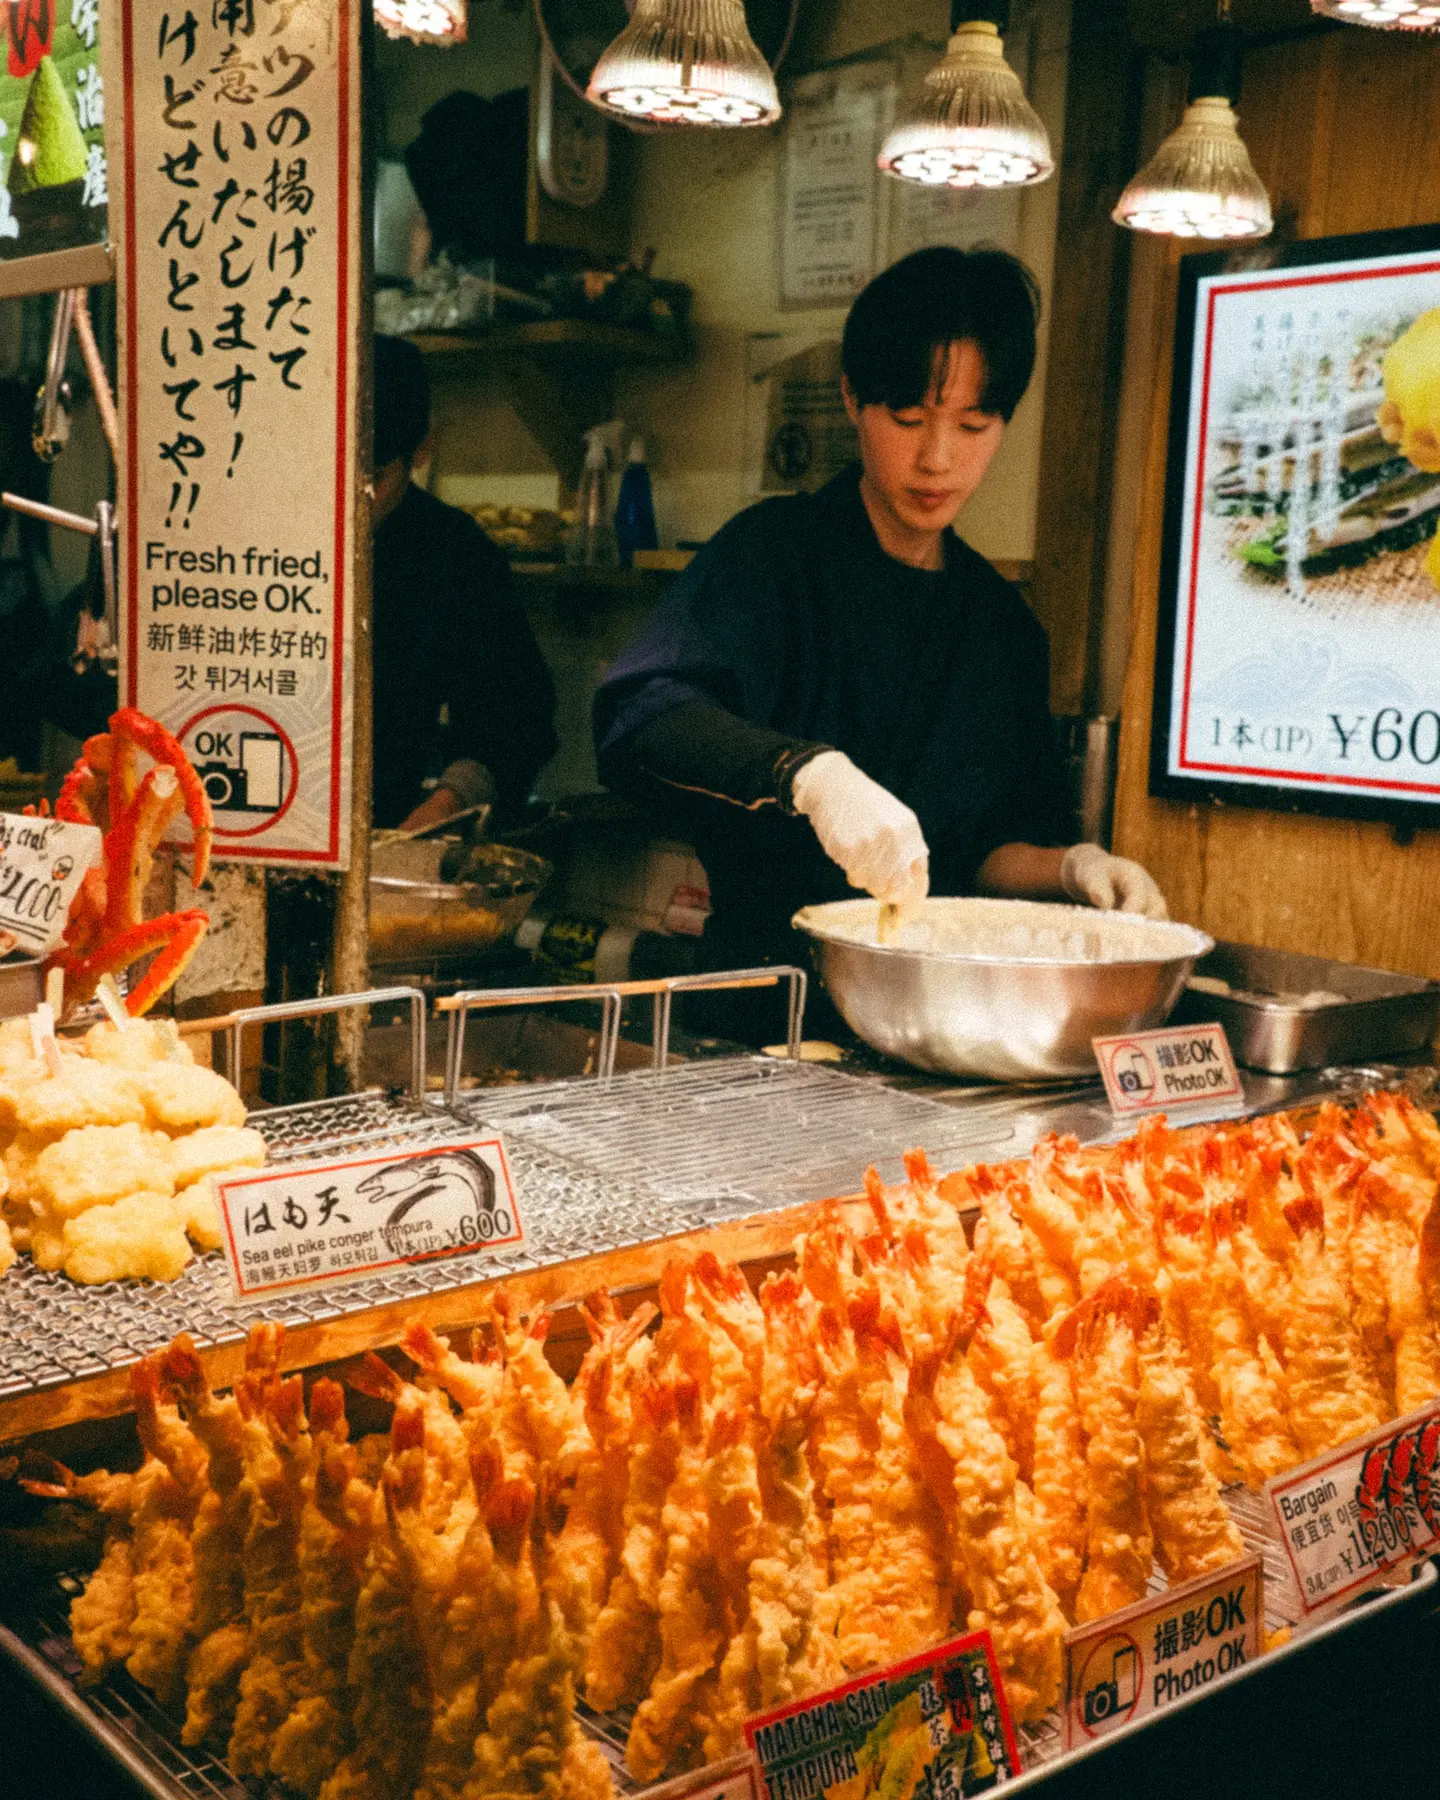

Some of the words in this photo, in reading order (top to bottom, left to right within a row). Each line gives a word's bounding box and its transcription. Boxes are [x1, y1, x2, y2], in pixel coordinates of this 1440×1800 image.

[146, 541, 236, 574] Fresh
[242, 546, 329, 583] fried,
[151, 578, 258, 612] please
[265, 583, 322, 614] OK.
[147, 622, 327, 661] 新鲜油炸好的
[194, 731, 234, 757] OK
[1163, 1071, 1207, 1094] Photo
[1204, 1066, 1228, 1088] OK
[244, 1185, 351, 1237] はも天
[445, 1208, 512, 1245] ¥600
[242, 1250, 270, 1266] Sea
[273, 1243, 294, 1260] eel
[296, 1237, 326, 1255] pike
[329, 1228, 375, 1248] conger
[378, 1219, 433, 1240] tempura
[1280, 1478, 1338, 1521] Bargain
[1153, 1585, 1247, 1666] 撮影OK
[1153, 1658, 1215, 1707] Photo
[1216, 1636, 1247, 1677] OK
[755, 1701, 842, 1765] MATCHA
[846, 1681, 892, 1729] SALT
